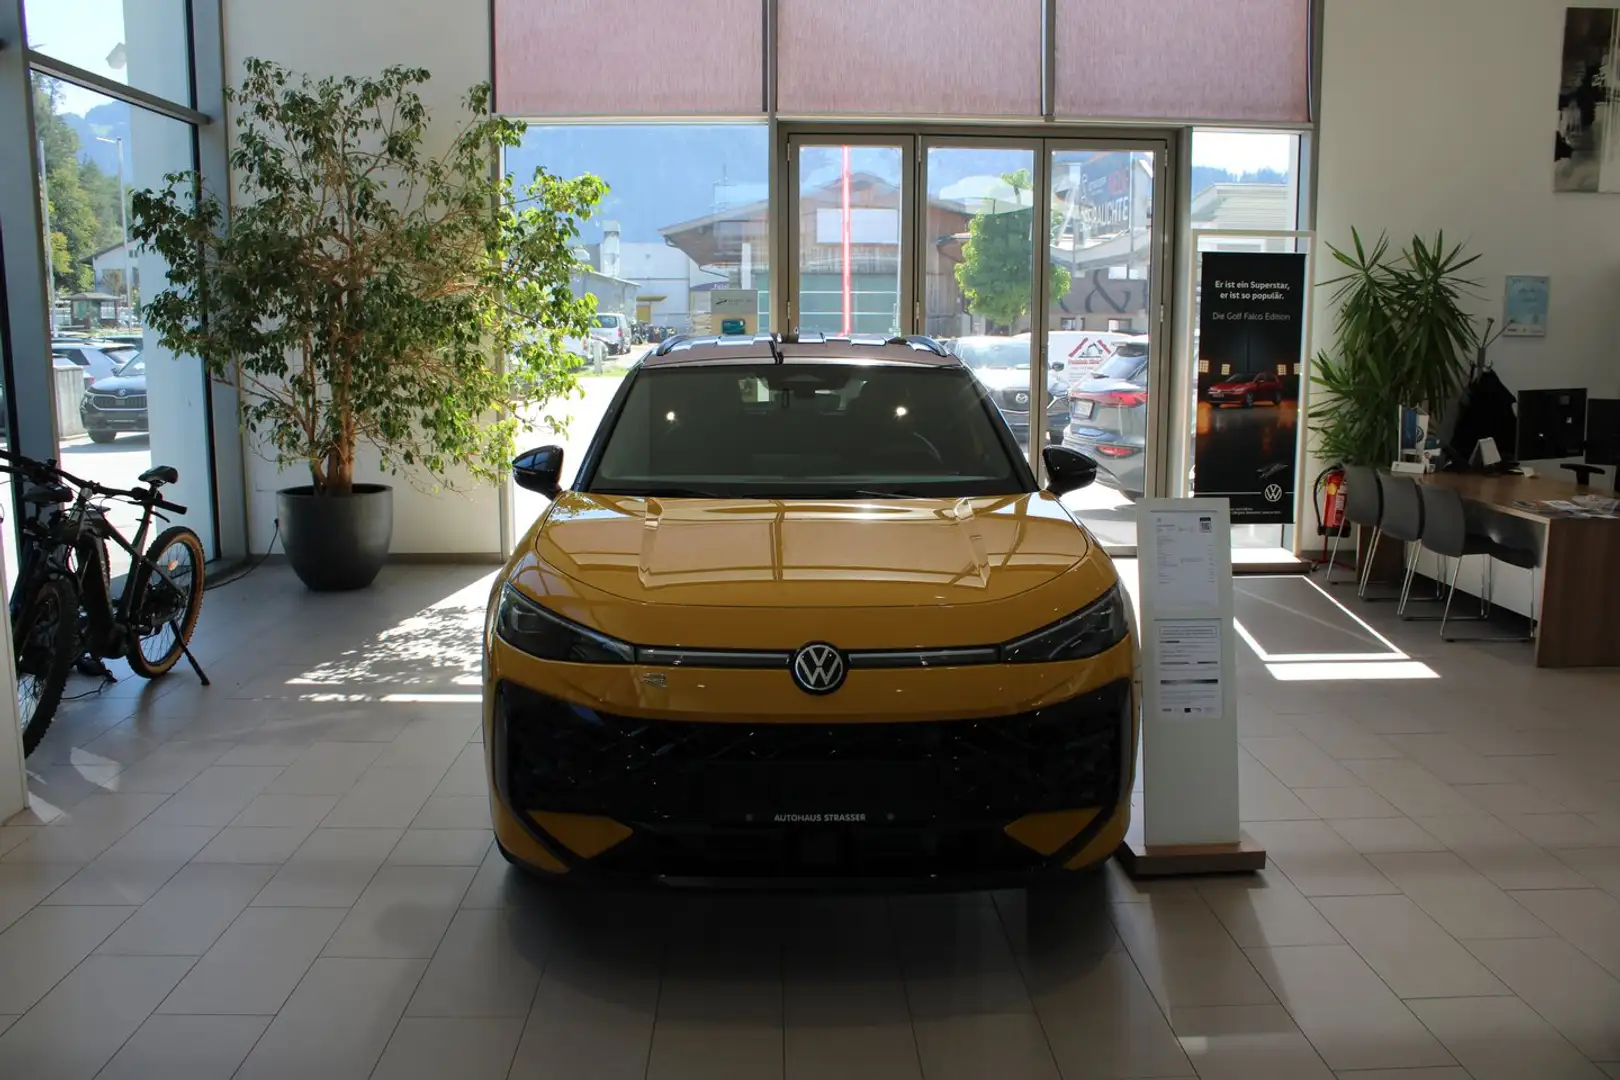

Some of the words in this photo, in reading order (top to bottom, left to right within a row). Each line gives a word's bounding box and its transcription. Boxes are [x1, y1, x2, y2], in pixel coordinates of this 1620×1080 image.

[1225, 280, 1235, 288] ist
[1236, 280, 1249, 288] ein
[1250, 281, 1290, 290] Superstar,
[1229, 291, 1240, 299] ist
[1252, 292, 1285, 301] populär.
[1212, 312, 1225, 320] Die
[1226, 312, 1243, 320] Golf
[1264, 312, 1291, 321] Edition
[797, 645, 842, 689] VW
[773, 813, 822, 822] AUTOHAUS
[824, 813, 866, 822] STRASSER
